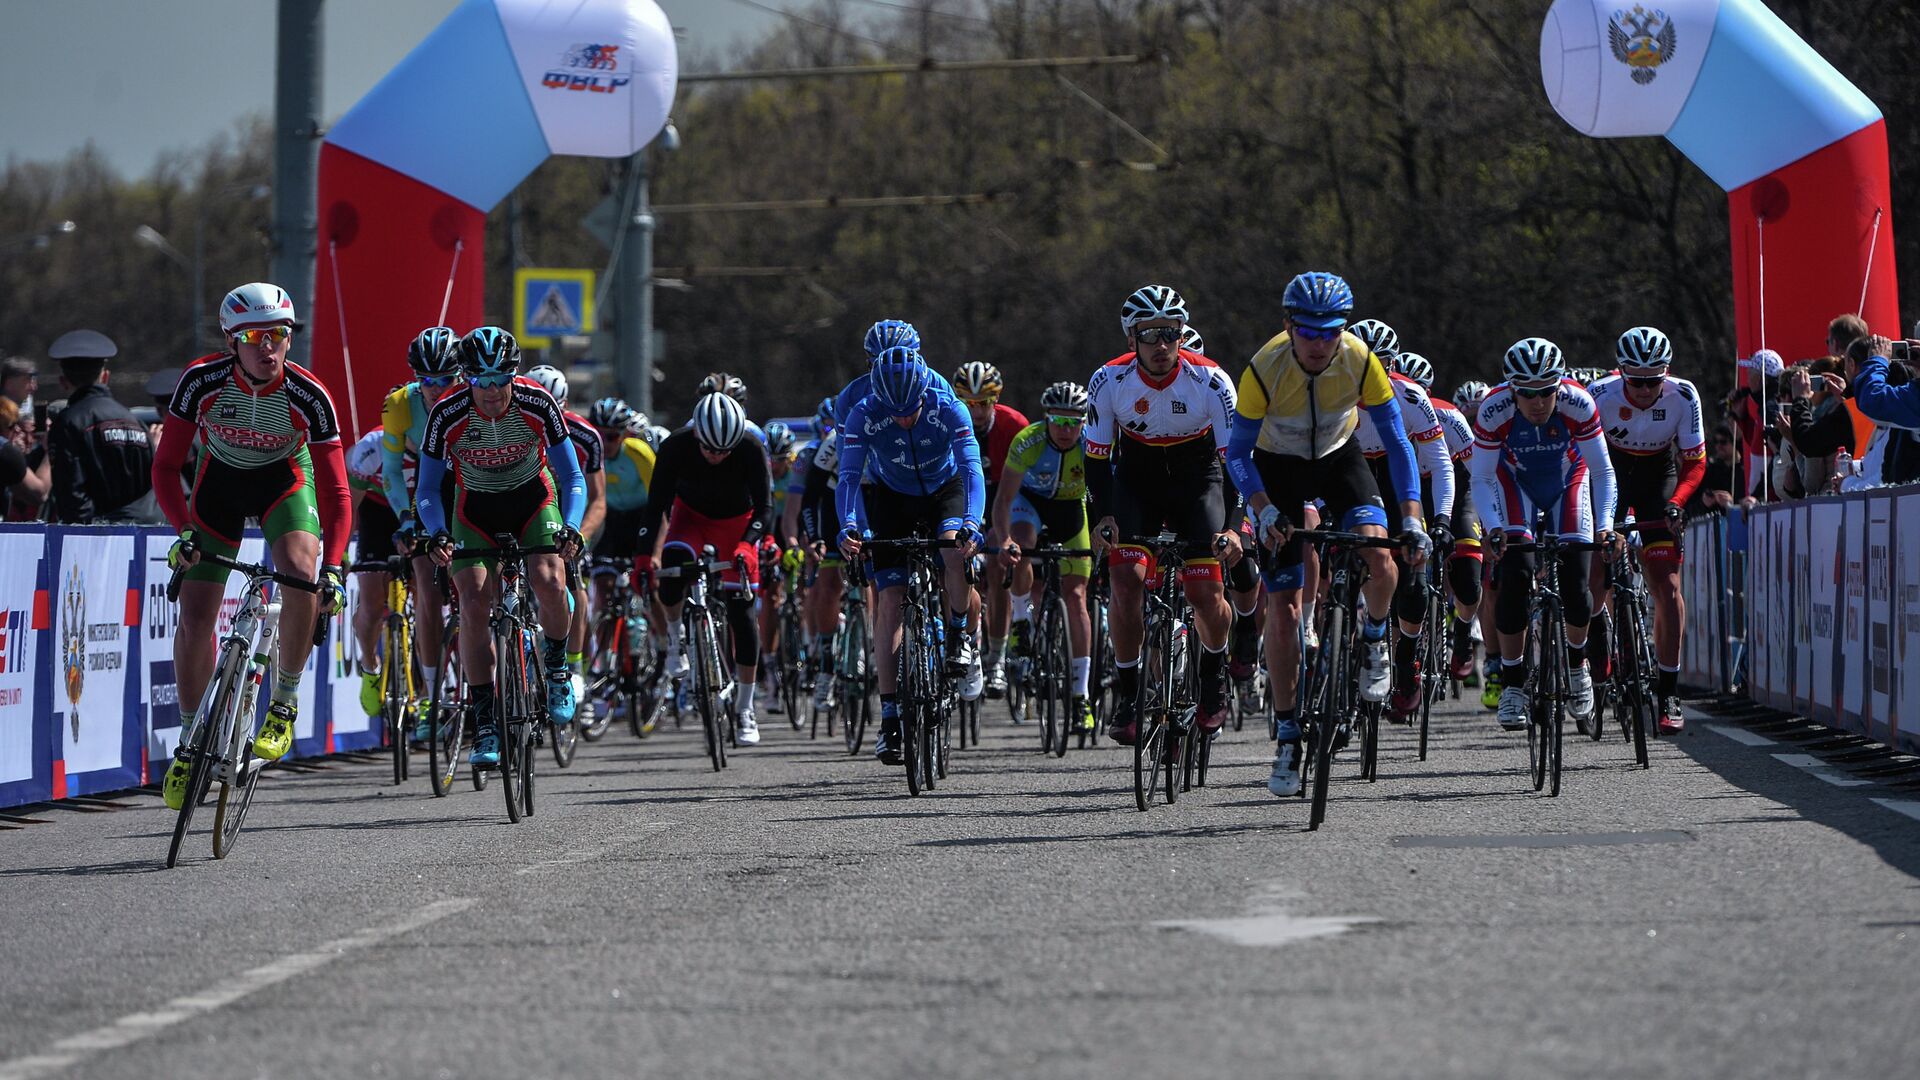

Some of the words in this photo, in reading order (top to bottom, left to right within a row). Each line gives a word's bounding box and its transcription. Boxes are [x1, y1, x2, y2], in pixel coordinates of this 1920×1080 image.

[542, 71, 630, 94] ФВСР
[179, 377, 203, 414] MOSCOW
[312, 399, 329, 433] REGION
[548, 404, 564, 438] REGION
[428, 414, 443, 453] MOSCOW
[458, 440, 535, 457] MOSCOW
